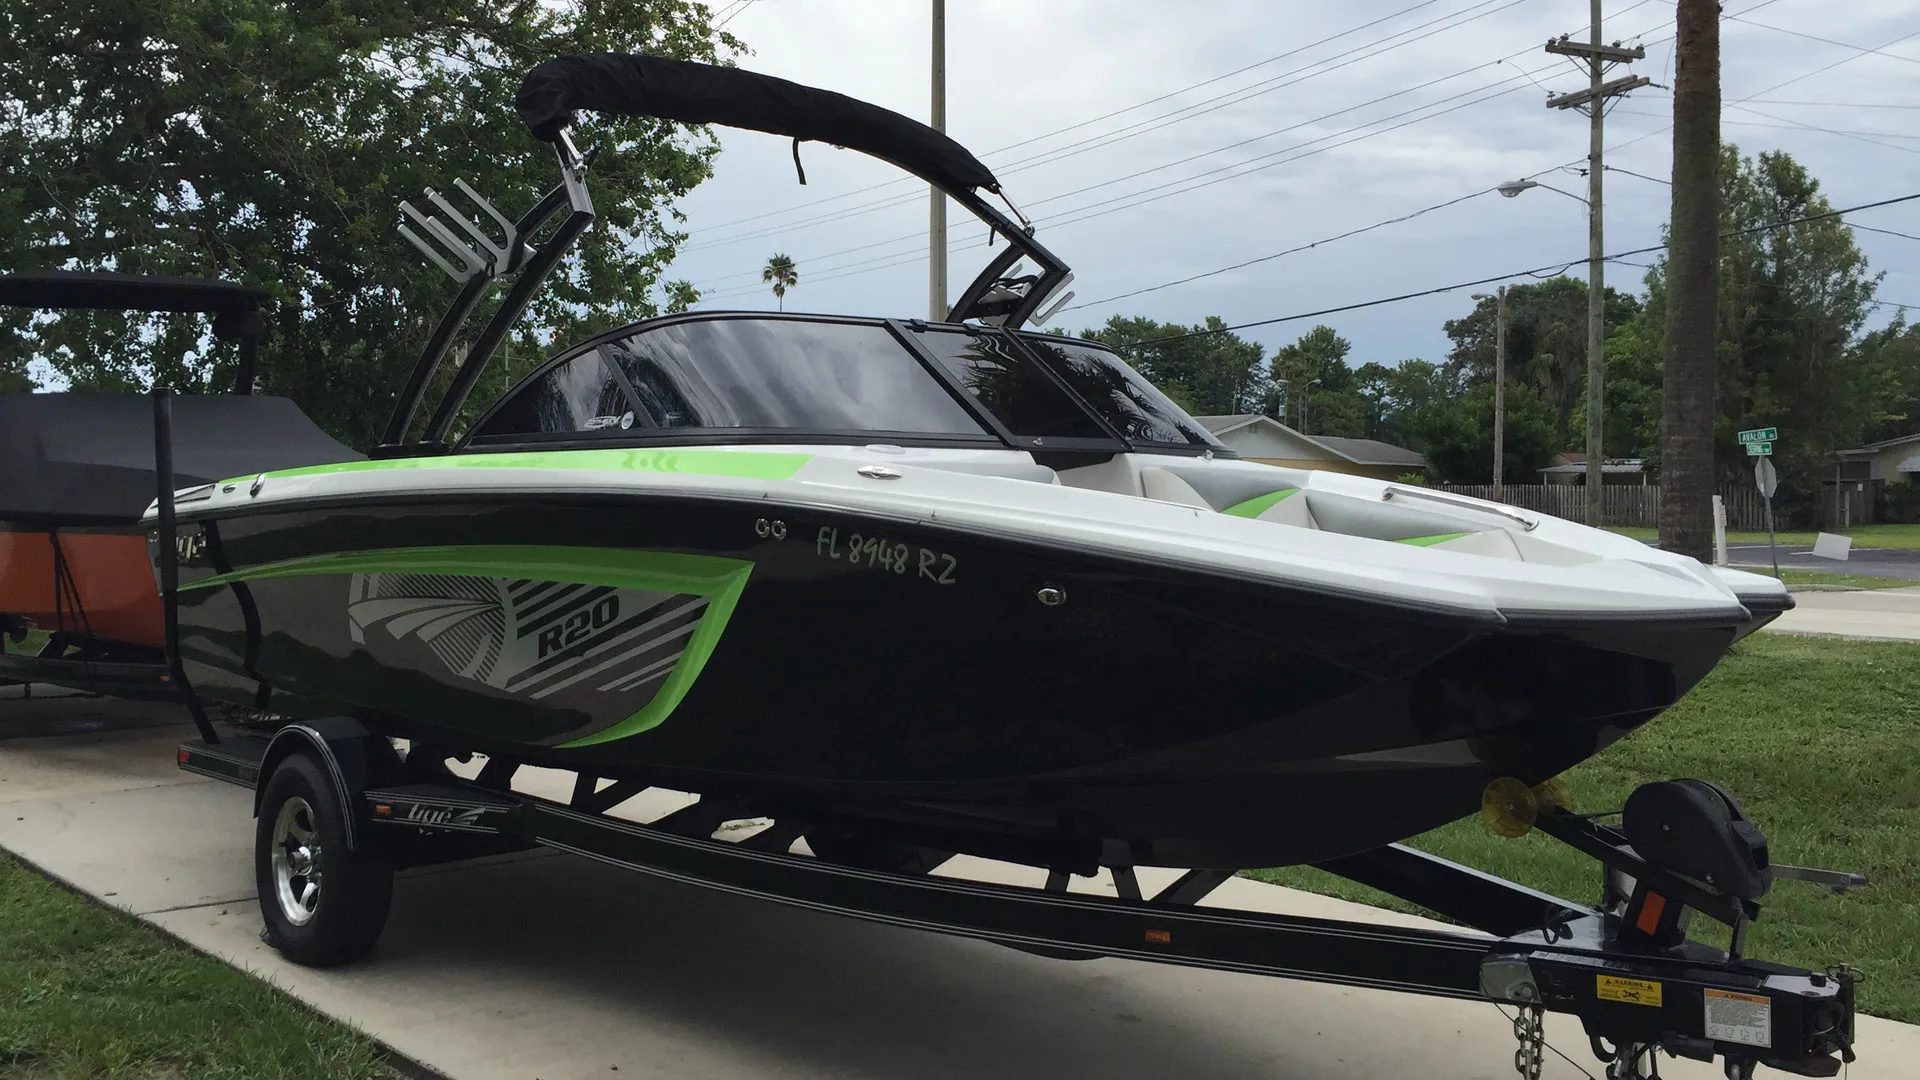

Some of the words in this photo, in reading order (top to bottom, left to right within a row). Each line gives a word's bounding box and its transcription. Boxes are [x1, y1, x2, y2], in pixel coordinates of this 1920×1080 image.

[816, 526, 841, 560] FL
[849, 533, 909, 574] 8948
[538, 595, 619, 660] R20
